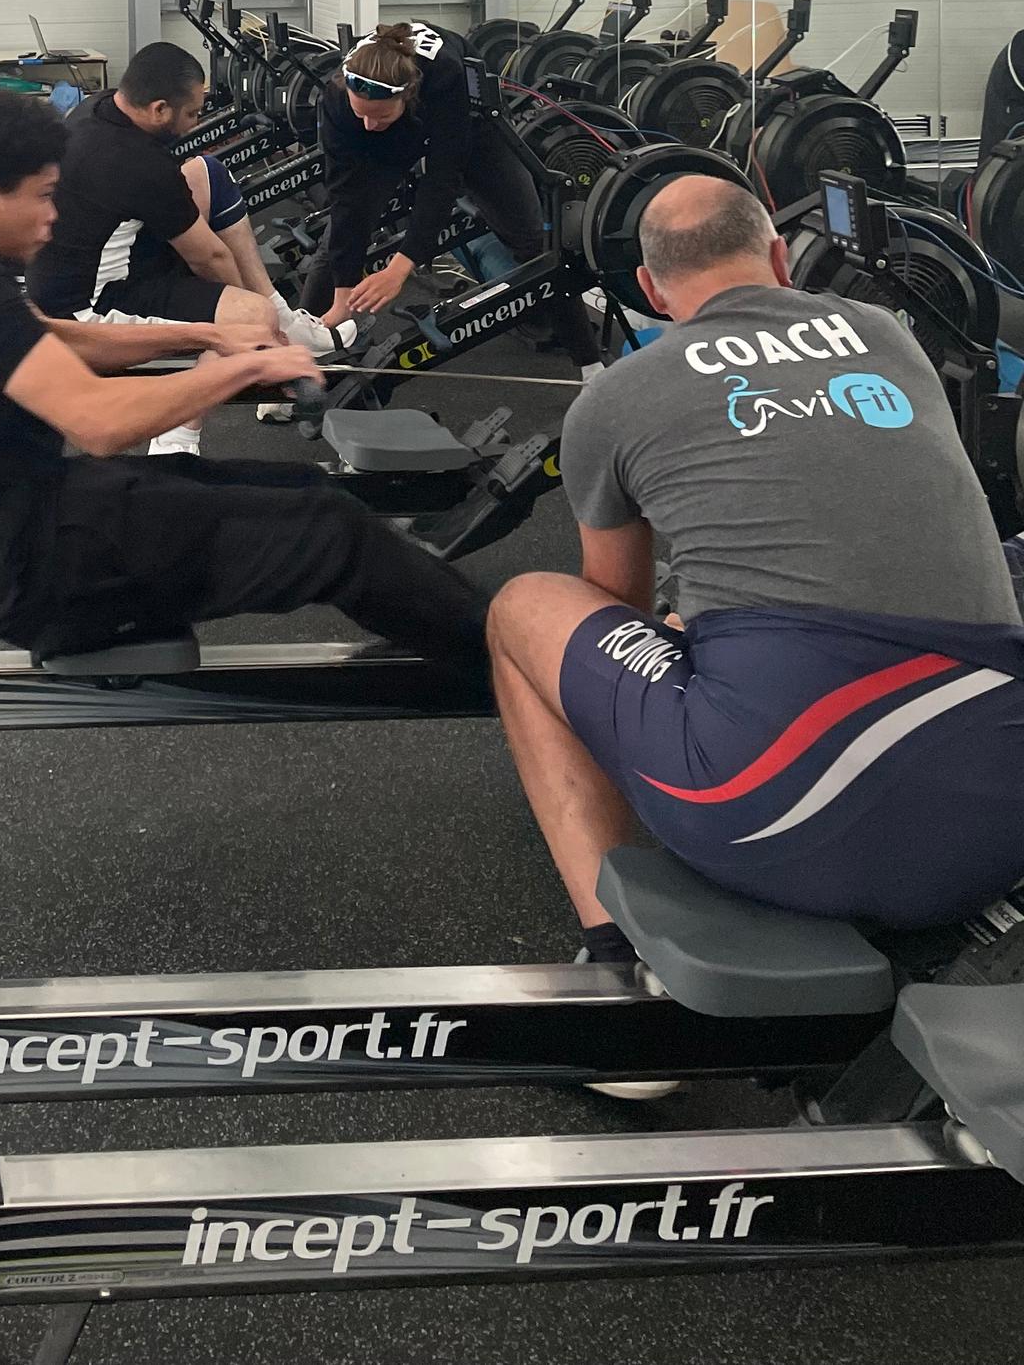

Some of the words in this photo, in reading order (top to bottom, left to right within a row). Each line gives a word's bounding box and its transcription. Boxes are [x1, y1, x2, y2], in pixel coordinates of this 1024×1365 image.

[205, 101, 214, 111] 2
[171, 124, 227, 157] oncept
[228, 118, 238, 130] 2
[259, 138, 270, 149] 2
[244, 169, 310, 208] oncept
[311, 163, 323, 175] 2
[388, 198, 401, 212] 2
[462, 216, 475, 229] 2
[449, 290, 537, 344] oncept
[539, 282, 555, 299] 2
[684, 313, 869, 375] COACH
[181, 1182, 774, 1273] incept-sport.fr
